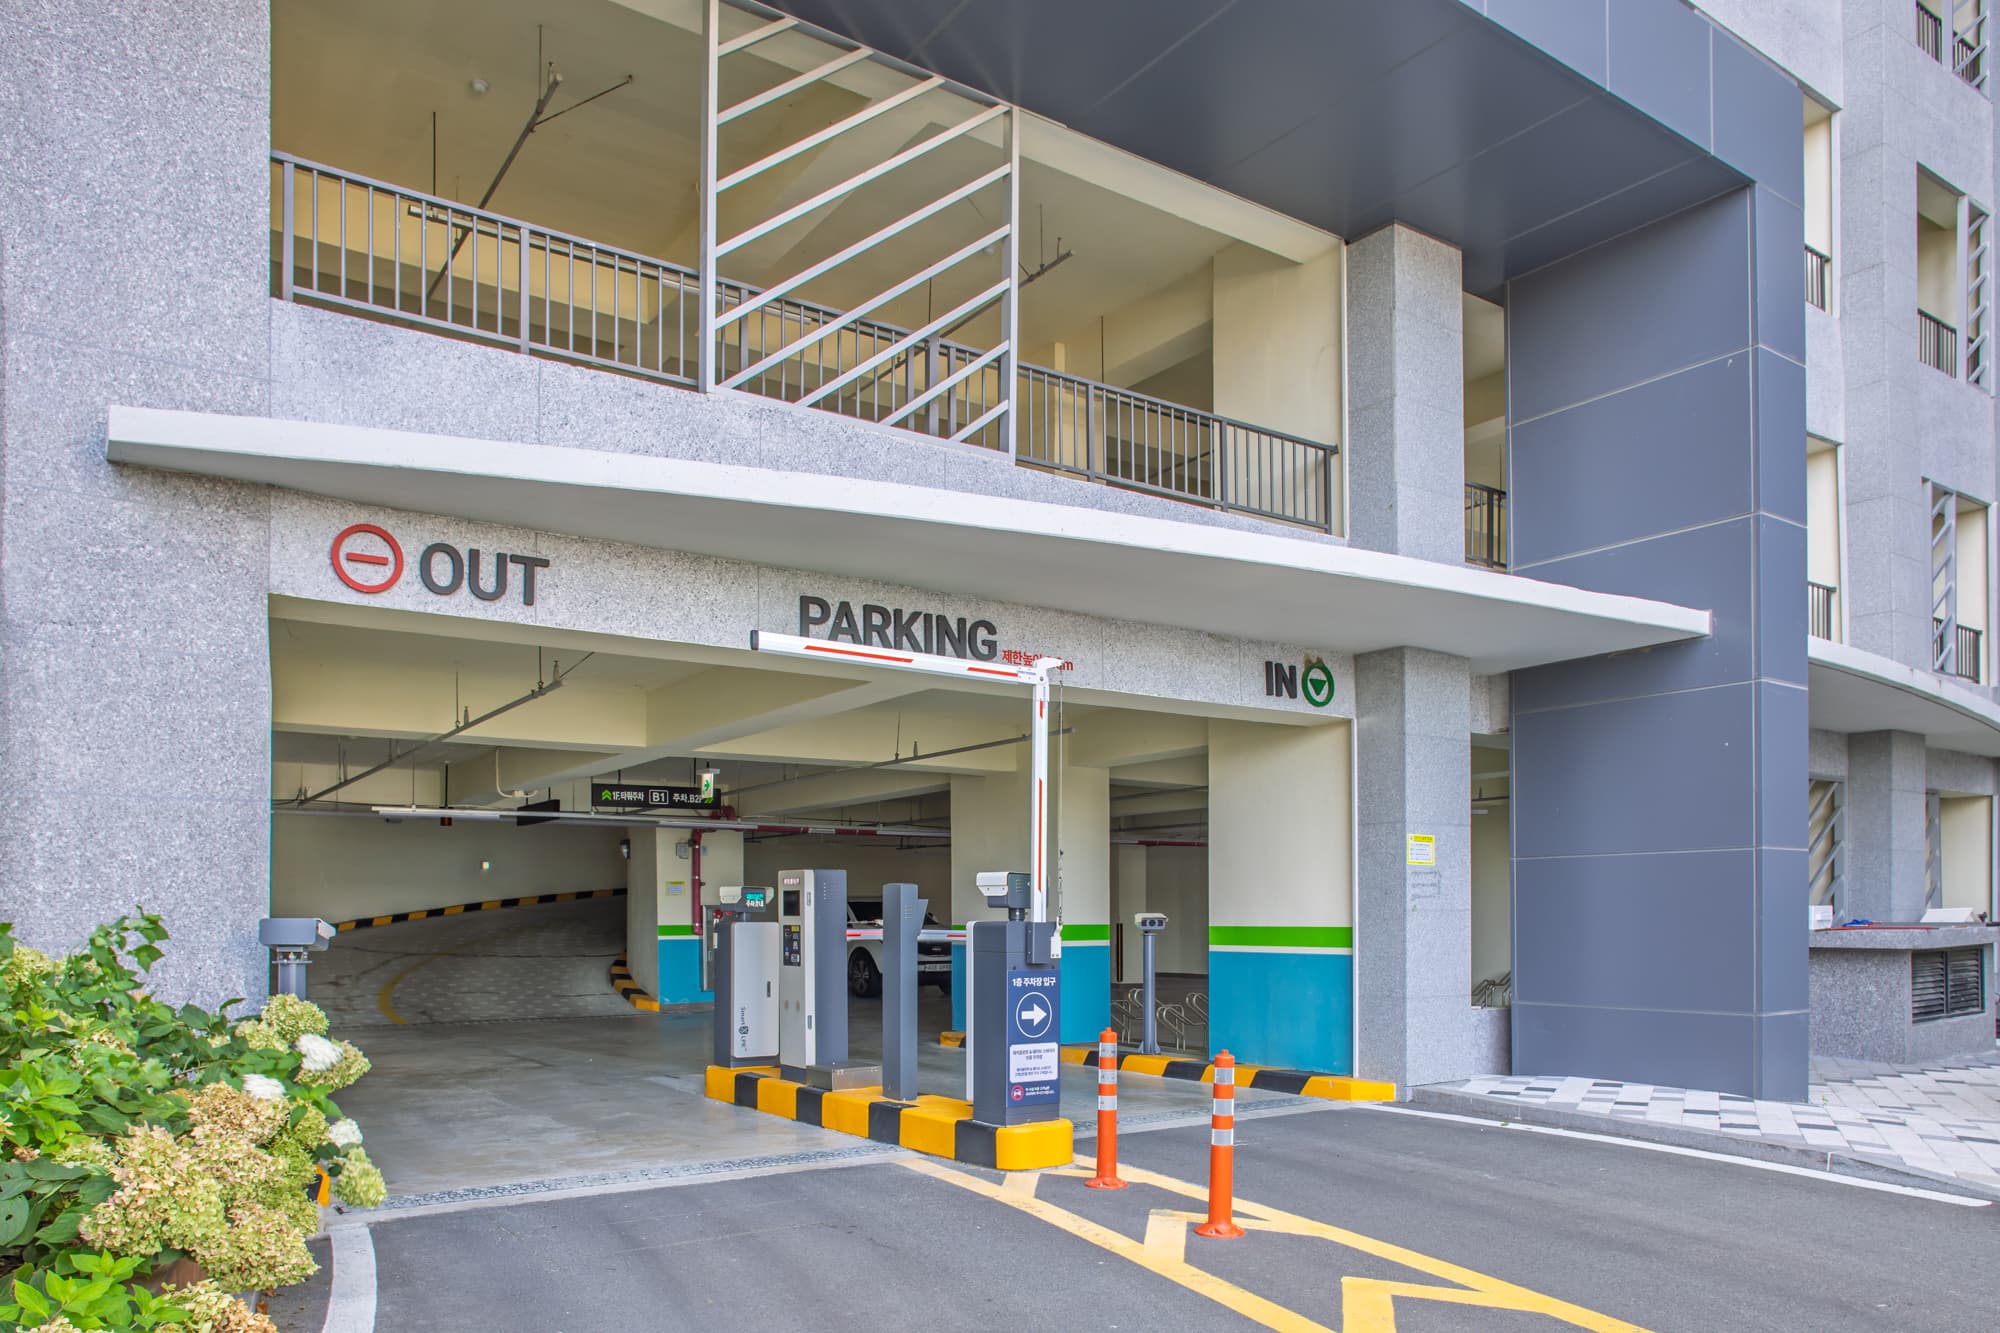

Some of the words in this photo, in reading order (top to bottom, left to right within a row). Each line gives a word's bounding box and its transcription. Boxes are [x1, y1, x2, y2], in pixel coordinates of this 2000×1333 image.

[419, 542, 550, 606] OUT
[799, 595, 998, 661] PARKING
[1265, 661, 1298, 699] IN
[652, 792, 665, 802] B1
[1012, 978, 1022, 987] 1층
[1023, 976, 1042, 987] 주차장
[1043, 976, 1056, 987] 입구
